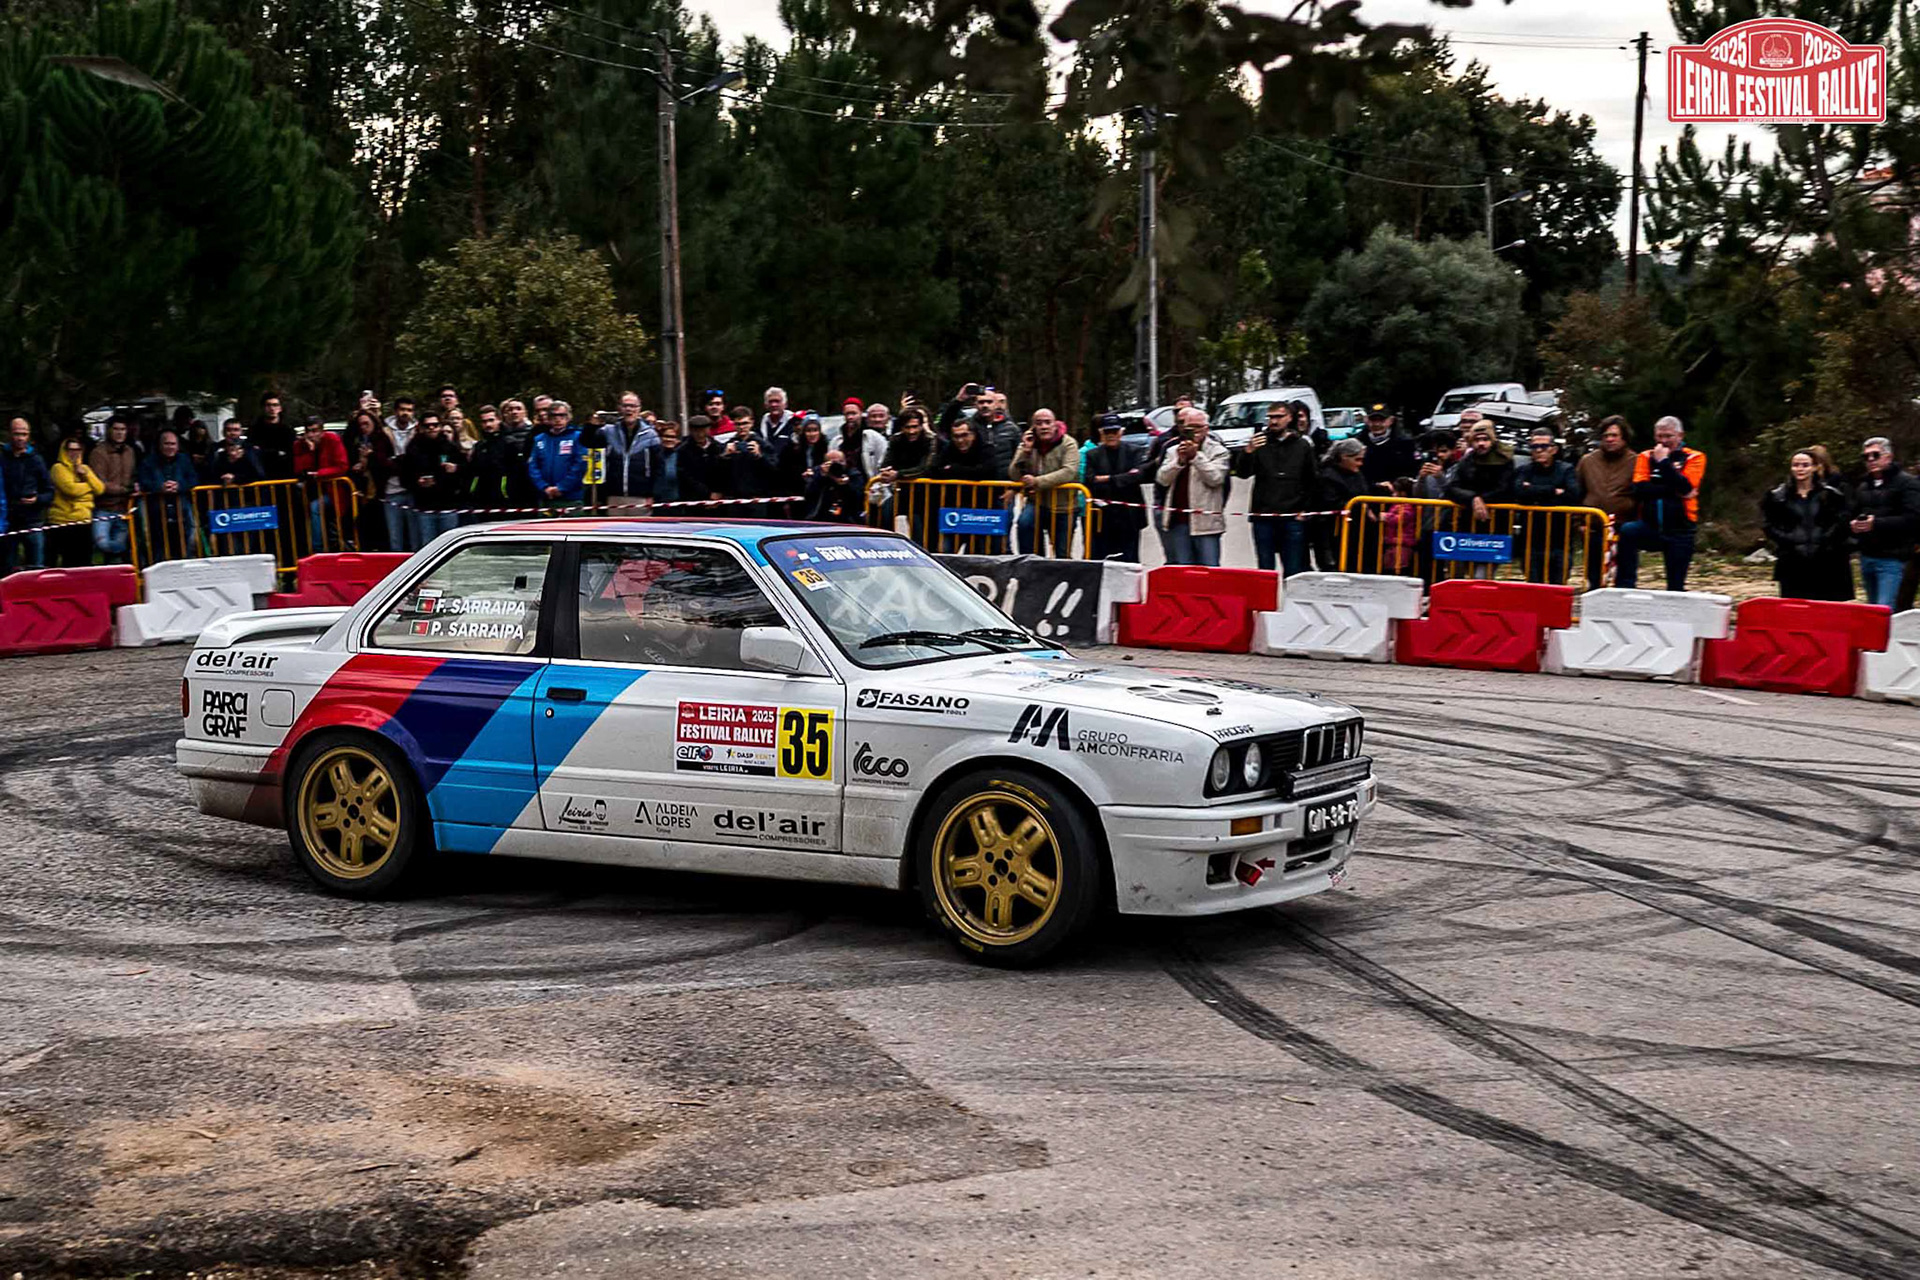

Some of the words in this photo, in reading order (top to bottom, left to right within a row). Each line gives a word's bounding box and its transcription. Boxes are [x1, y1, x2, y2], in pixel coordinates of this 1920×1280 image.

[853, 549, 917, 560] Motorsport
[799, 569, 825, 585] 35
[436, 599, 447, 613] F.
[450, 600, 526, 616] SARRAIPA
[431, 621, 444, 636] P.
[448, 622, 525, 639] SARRAIPA
[203, 690, 248, 715] PARCI
[879, 693, 970, 709] FASANO
[699, 705, 747, 723] LEIRIA
[752, 710, 775, 723] 2025
[203, 713, 247, 738] GRAF
[680, 724, 731, 742] FESTIVAL
[733, 730, 774, 744] RALLYE
[1078, 729, 1128, 744] GRUPO
[782, 710, 829, 777] 35
[677, 746, 700, 760] elf
[1076, 744, 1184, 763] AMCONFRARIA
[656, 803, 698, 817] ALDEIA
[656, 815, 691, 828] LOPES
[759, 834, 826, 845] COMPRESSORES
